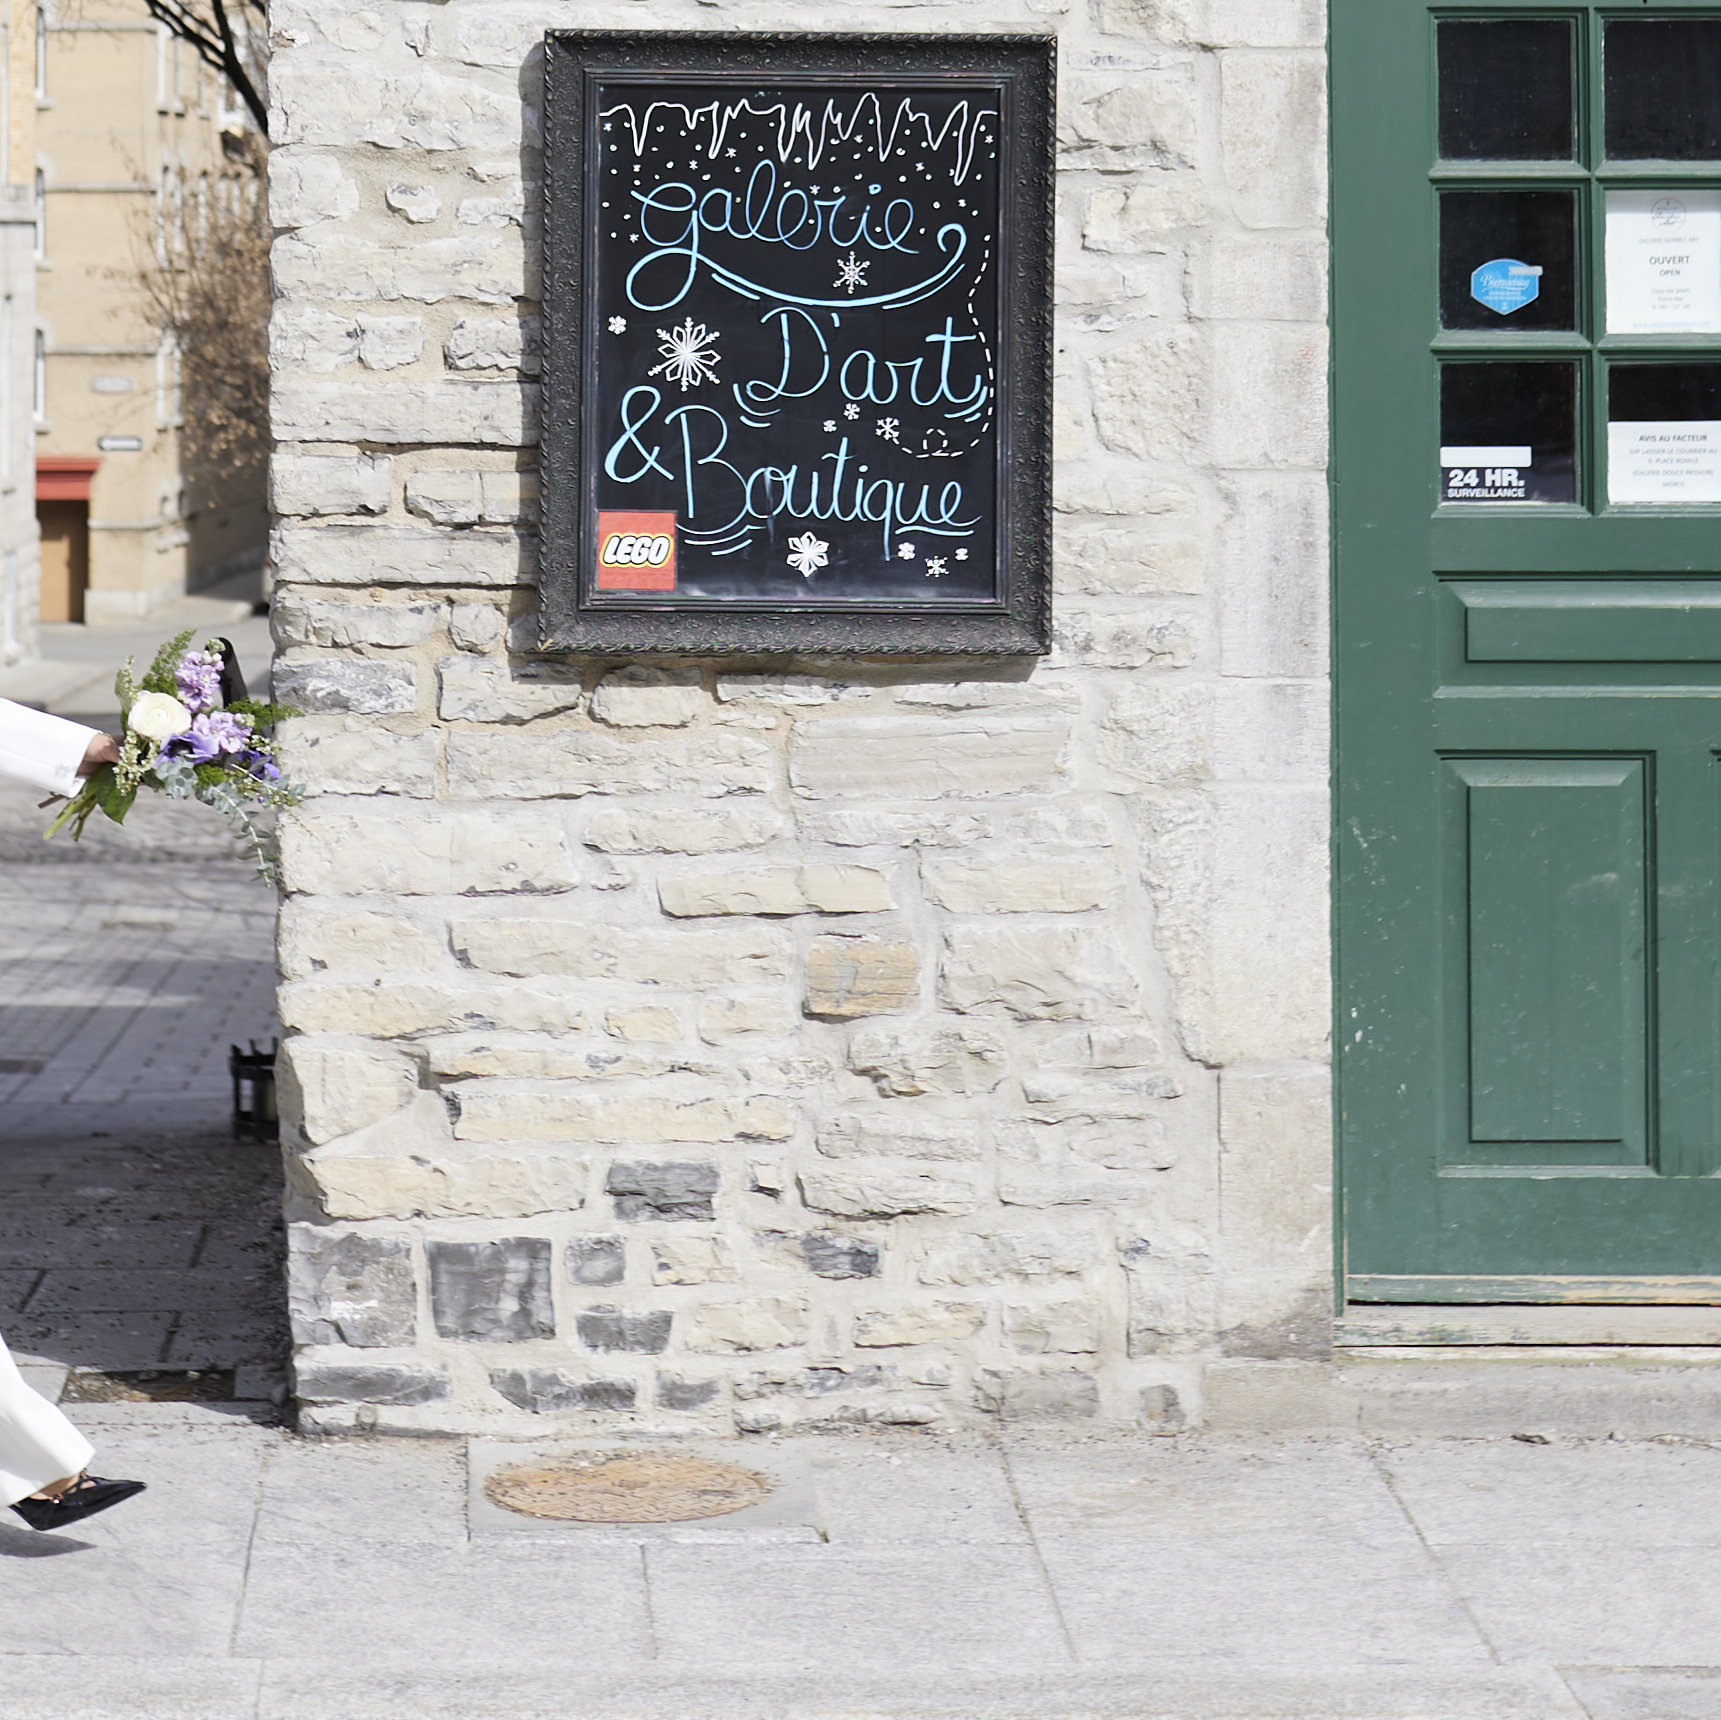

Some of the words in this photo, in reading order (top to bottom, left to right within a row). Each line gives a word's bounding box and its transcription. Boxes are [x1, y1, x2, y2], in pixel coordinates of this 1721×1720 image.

[1649, 255, 1690, 265] OUVERT
[1659, 269, 1681, 277] OPEN
[1672, 434, 1708, 442] FACTEUR
[604, 384, 675, 483] &
[665, 404, 982, 562] Boutique
[1448, 468, 1480, 487] 24
[1484, 468, 1525, 487] HR.
[1447, 487, 1525, 498] SURVEILLANCE
[601, 533, 672, 567] LEGO
